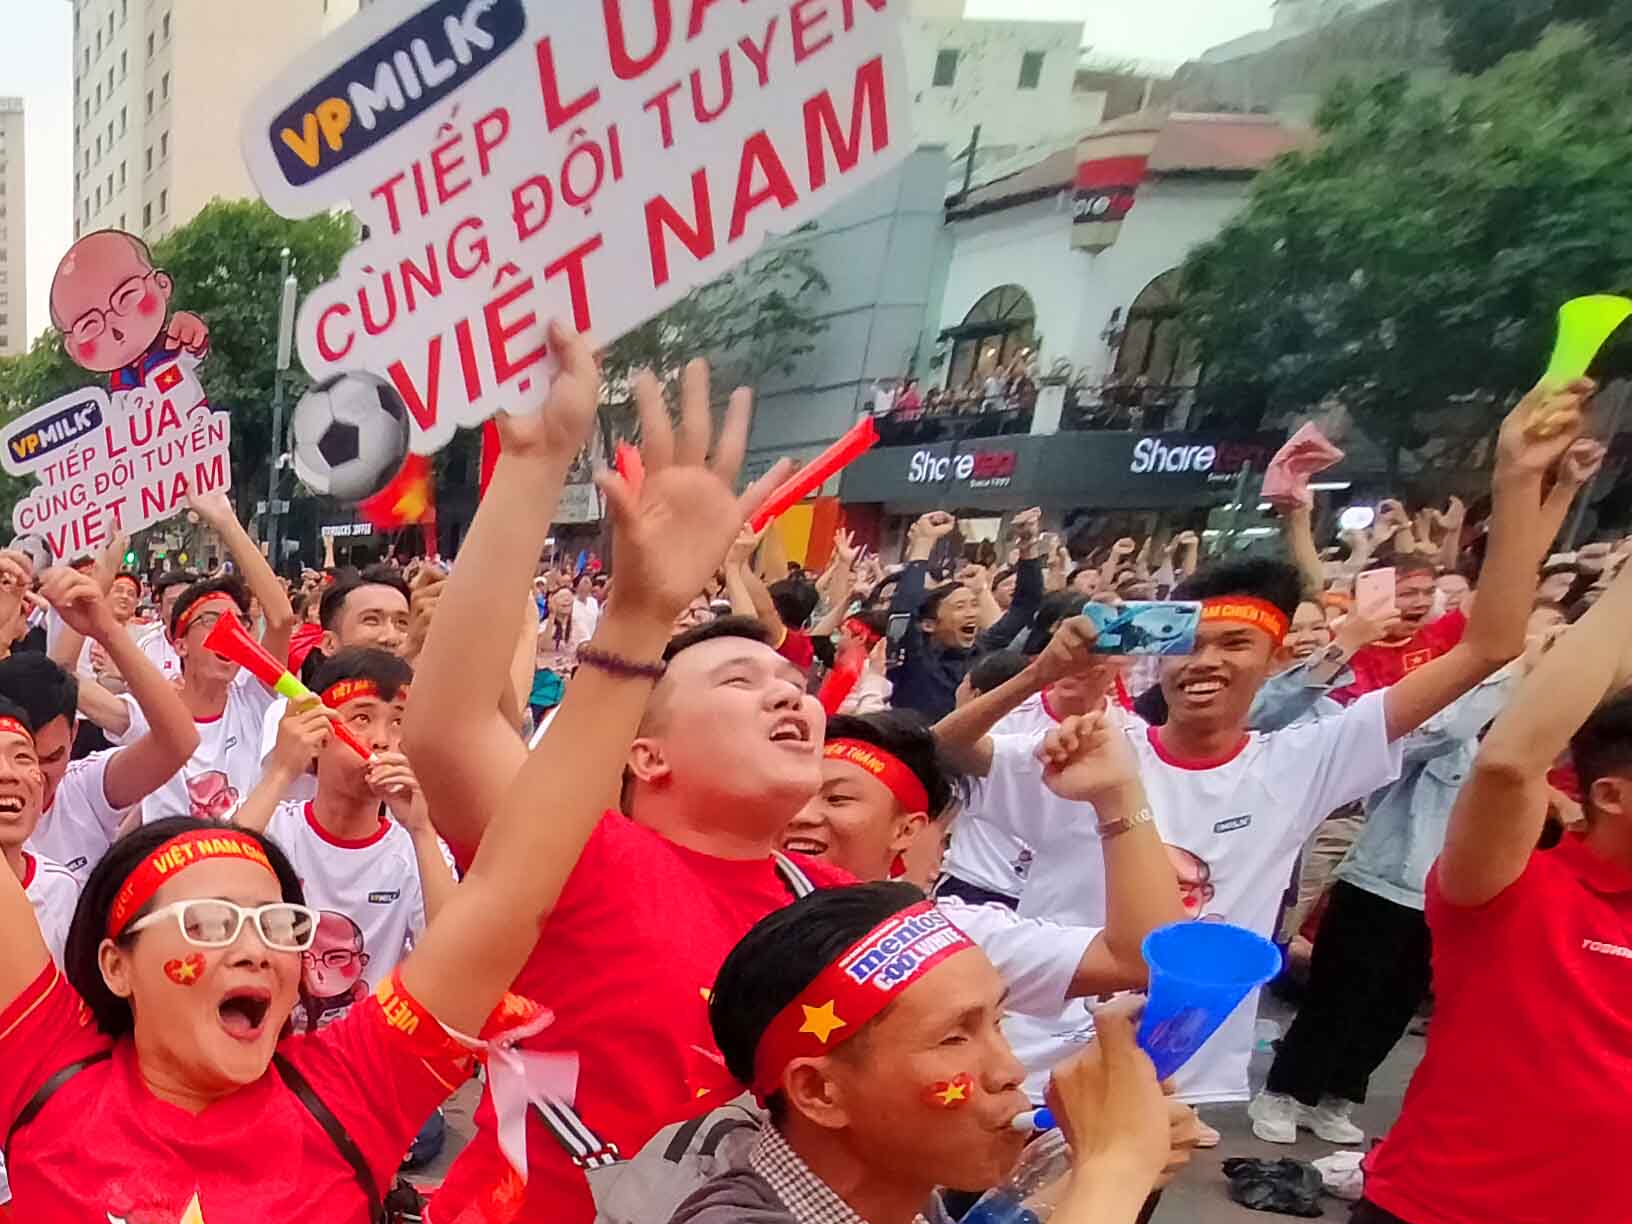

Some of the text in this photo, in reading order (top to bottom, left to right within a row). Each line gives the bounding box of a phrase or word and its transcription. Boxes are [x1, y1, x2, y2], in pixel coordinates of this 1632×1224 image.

[371, 103, 510, 235] TIẾP
[316, 216, 490, 363] CÙNG
[511, 122, 624, 242] ĐỘI
[386, 54, 889, 432] VIỆT NAM
[11, 402, 96, 459] VPMILK
[43, 442, 97, 487] TIẾP
[47, 453, 225, 560] VIỆT NAM
[152, 841, 195, 875] VIỆT
[197, 838, 242, 857] NAM
[848, 909, 948, 982] mentos
